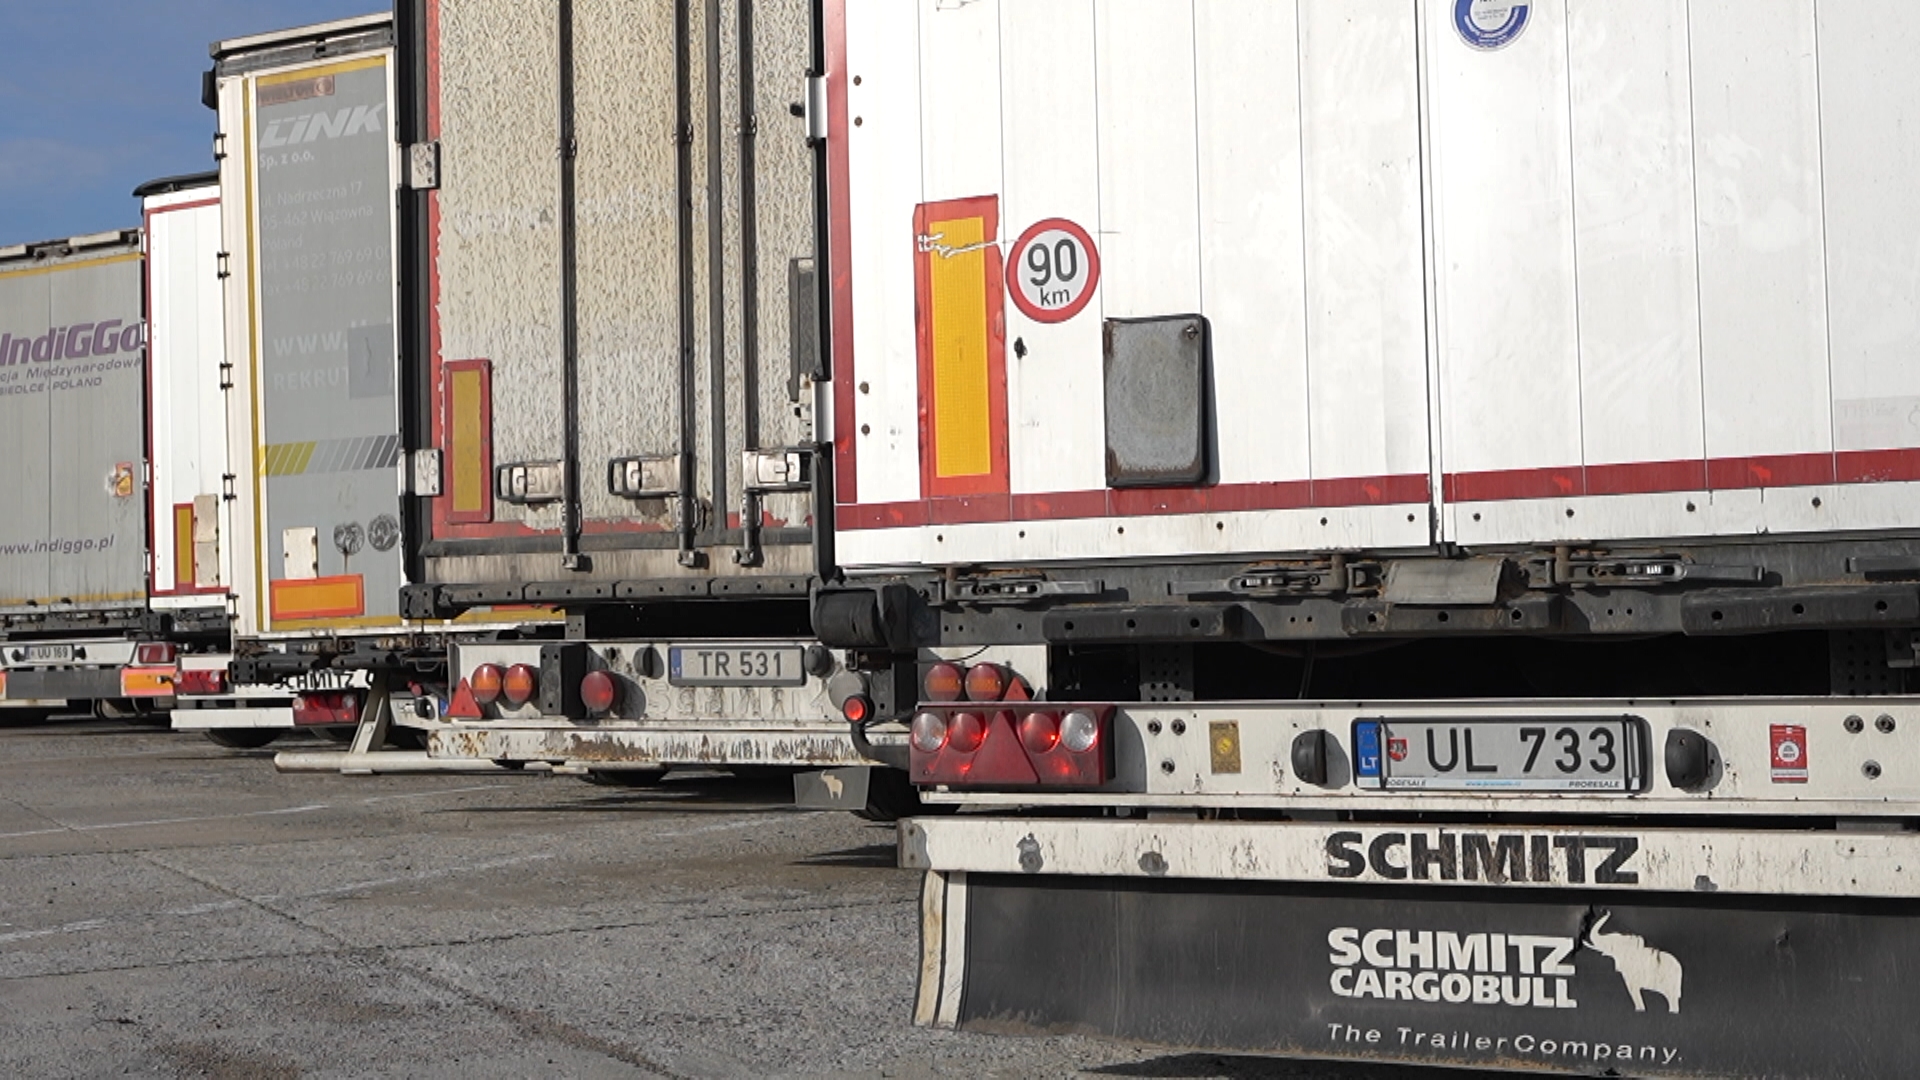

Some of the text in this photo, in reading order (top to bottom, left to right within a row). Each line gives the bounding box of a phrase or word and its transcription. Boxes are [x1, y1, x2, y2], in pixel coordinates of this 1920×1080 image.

[260, 101, 385, 149] LINK
[277, 186, 347, 206] Nadrzeczna
[350, 181, 362, 196] 17
[311, 205, 373, 225] Wiązowna
[330, 248, 353, 265] 769
[356, 246, 372, 262] 69
[1027, 238, 1078, 287] 90
[1040, 287, 1070, 306] km
[0, 319, 140, 366] IndiGGo
[53, 378, 102, 390] POLAND
[273, 366, 348, 391] REKRUT
[698, 651, 781, 677] TR 531
[1361, 756, 1378, 769] LT
[1426, 727, 1616, 774] UL 733
[1325, 830, 1639, 884] SCHMITZ
[1327, 926, 1576, 976] SCHMITZ
[1330, 969, 1578, 1008] CARGOBULL
[1327, 1023, 1382, 1043] The
